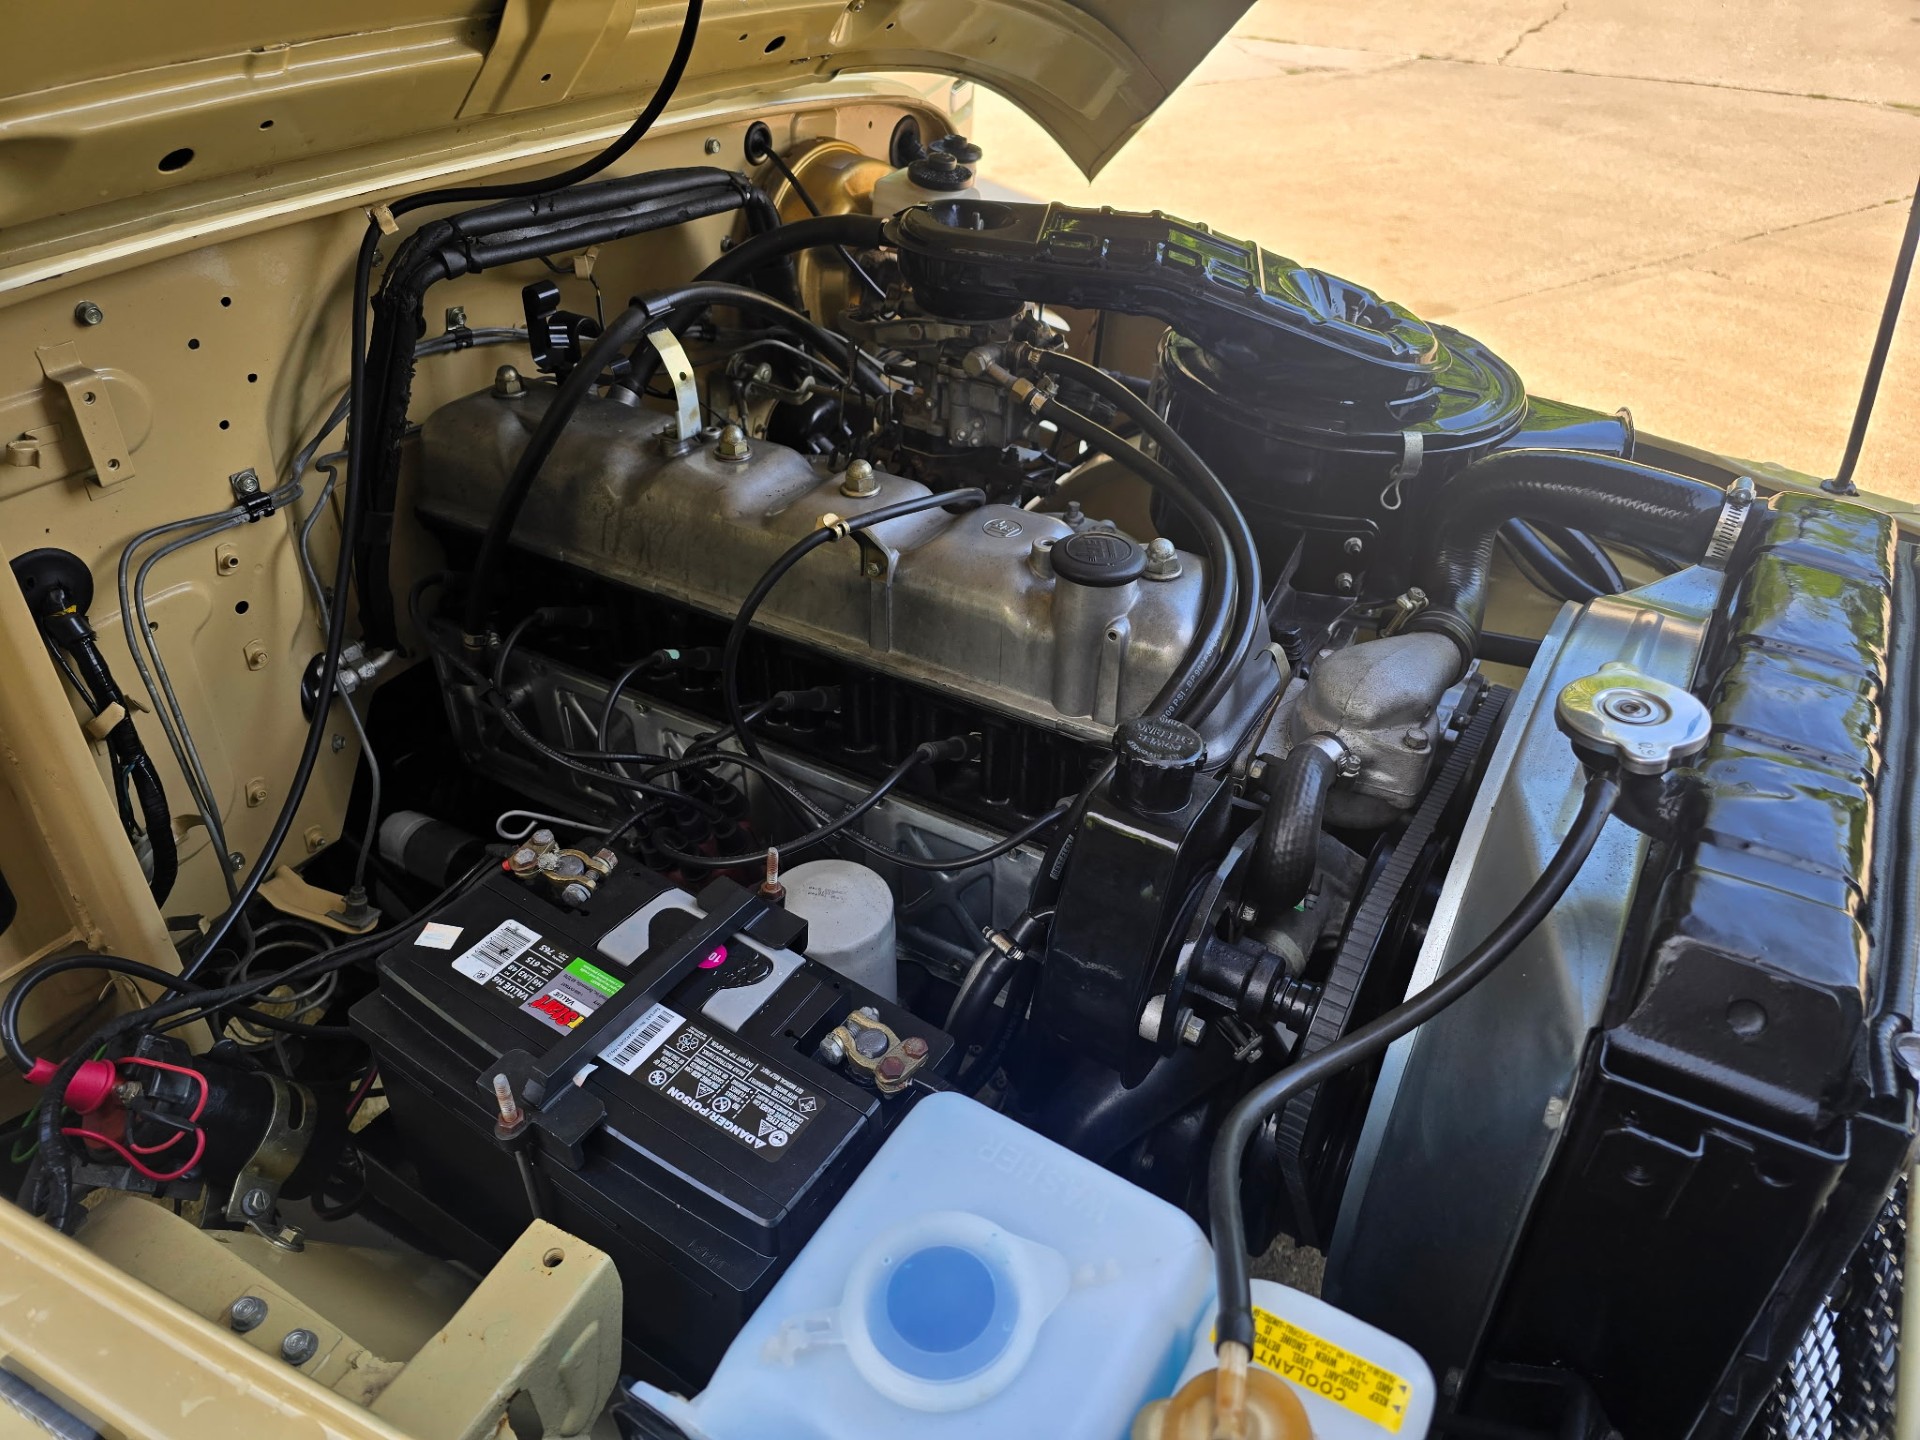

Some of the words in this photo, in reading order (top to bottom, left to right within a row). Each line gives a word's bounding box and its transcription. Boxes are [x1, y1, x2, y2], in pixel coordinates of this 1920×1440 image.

[1173, 691, 1186, 707] PSI
[787, 784, 806, 801] JAPAN
[539, 944, 554, 955] 765
[525, 957, 540, 966] 615
[708, 952, 721, 962] 10
[492, 976, 505, 985] H6
[518, 970, 532, 980] LN3
[532, 979, 543, 987] H6
[502, 982, 528, 999] VALUE
[553, 991, 574, 1005] VALUE
[530, 994, 585, 1029] rStart
[710, 1073, 724, 1083] CAUSE
[729, 1085, 746, 1097] FLAMES
[667, 1087, 754, 1141] DANGER/POISON
[777, 1122, 795, 1134] SHIELD
[1252, 1331, 1280, 1352] BETWE
[1280, 1334, 1306, 1352] ENGINE
[1293, 1352, 1313, 1368] LEVEL
[1316, 1352, 1336, 1366] WHEN
[1256, 1351, 1345, 1400] COOLANT
[1324, 1370, 1357, 1391] COOLANT
[1378, 1381, 1392, 1394] AND
[1369, 1392, 1388, 1406] KEEP
